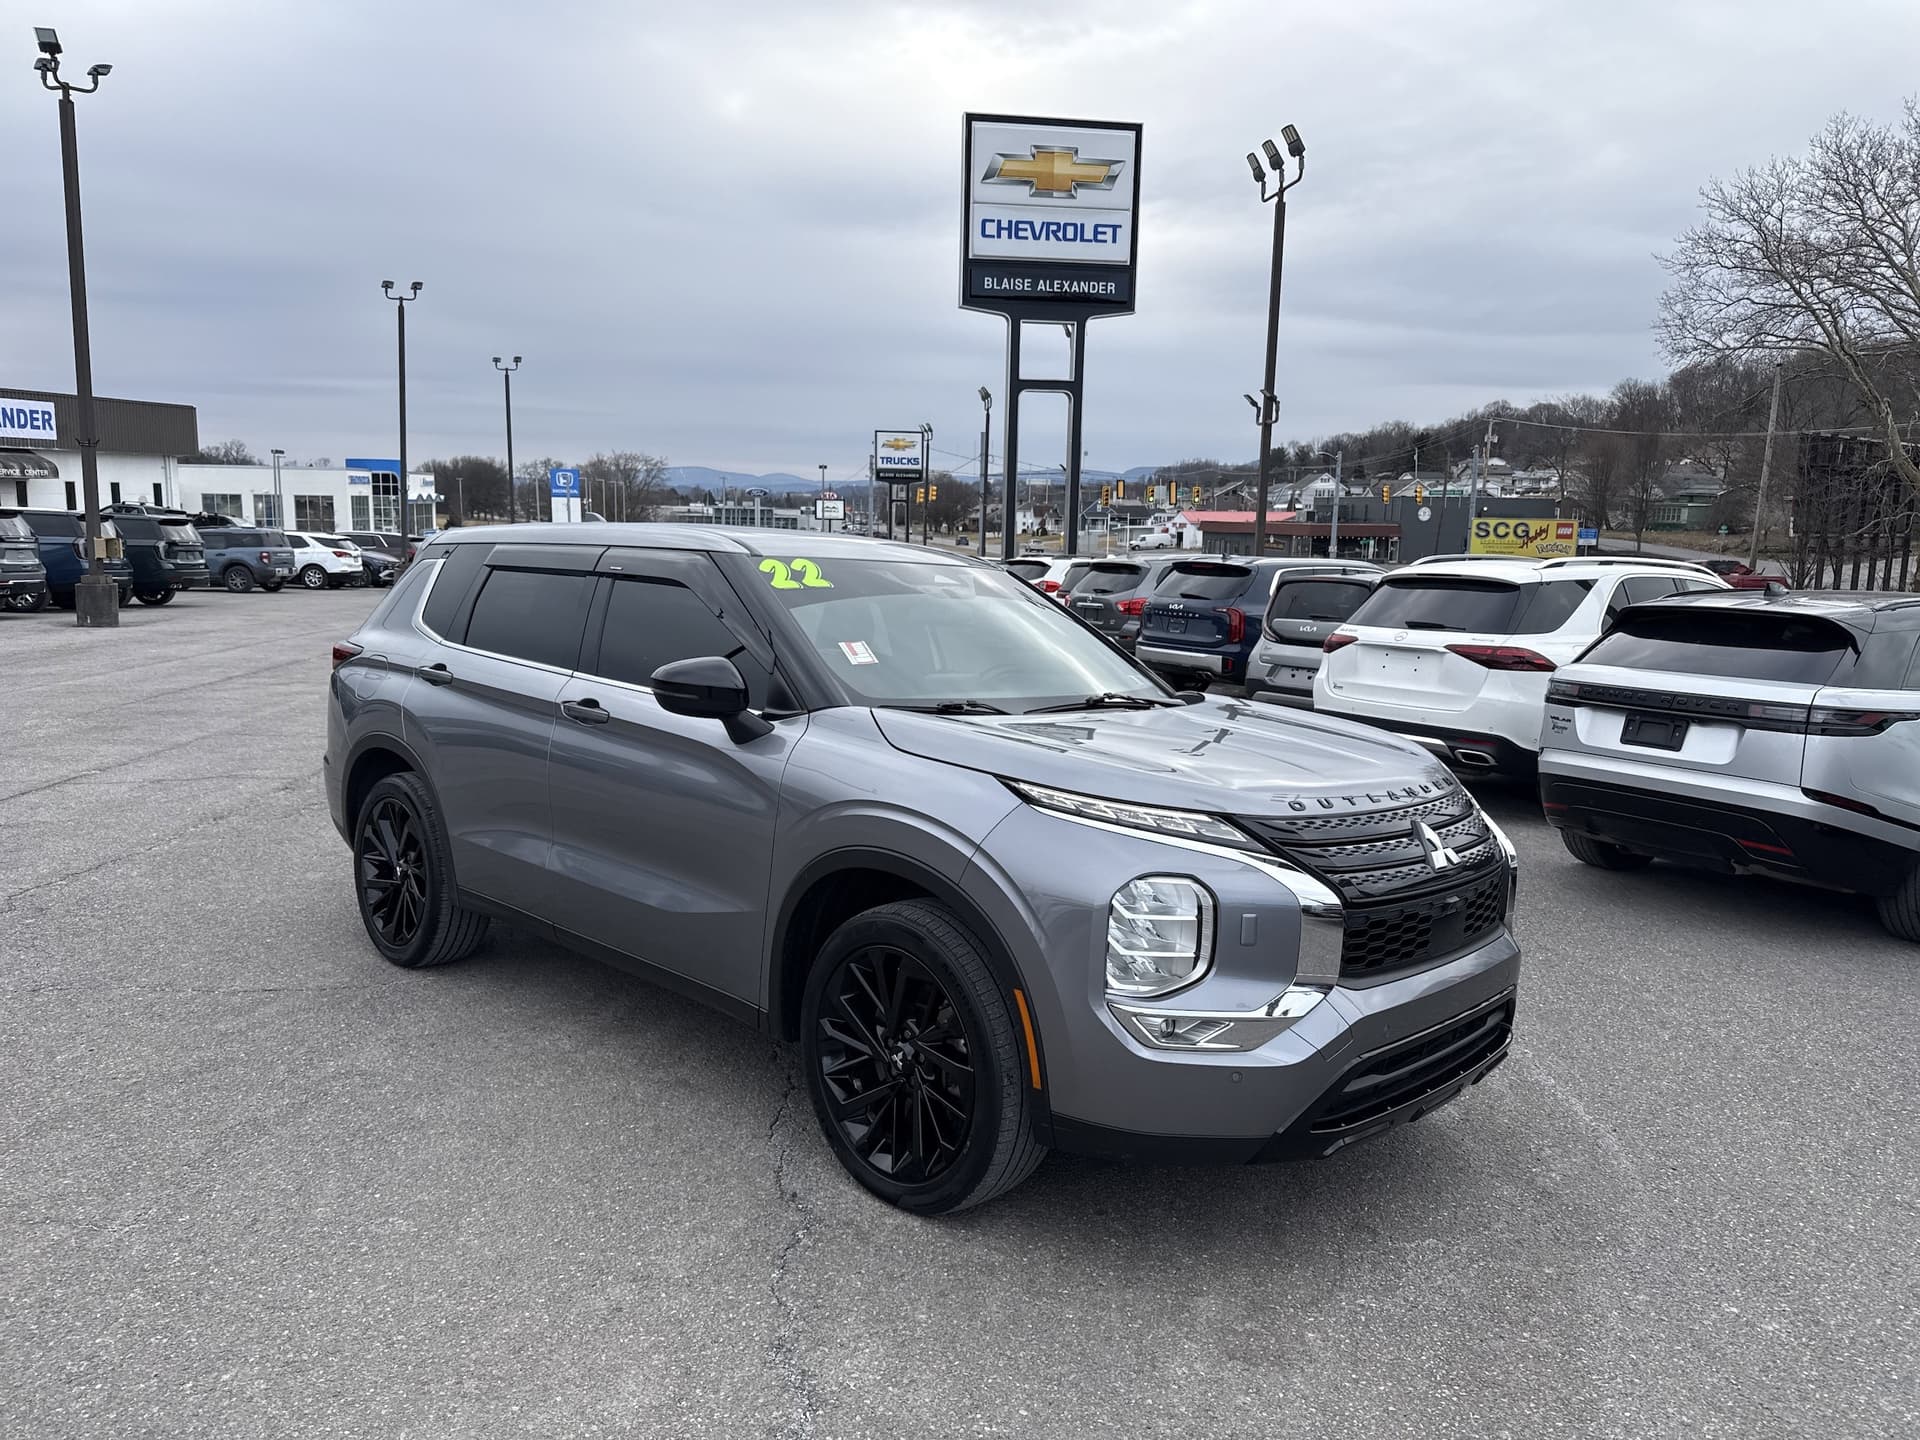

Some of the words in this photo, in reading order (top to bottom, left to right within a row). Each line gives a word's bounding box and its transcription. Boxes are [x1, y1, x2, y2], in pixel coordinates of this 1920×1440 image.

[981, 218, 1122, 244] CHEVROLET
[984, 277, 1032, 291] BLAISE
[1037, 279, 1116, 294] ALEXANDER
[0, 407, 54, 431] NDER
[880, 456, 920, 465] TRUCKS
[1475, 521, 1530, 538] SCG
[758, 558, 834, 589] 22
